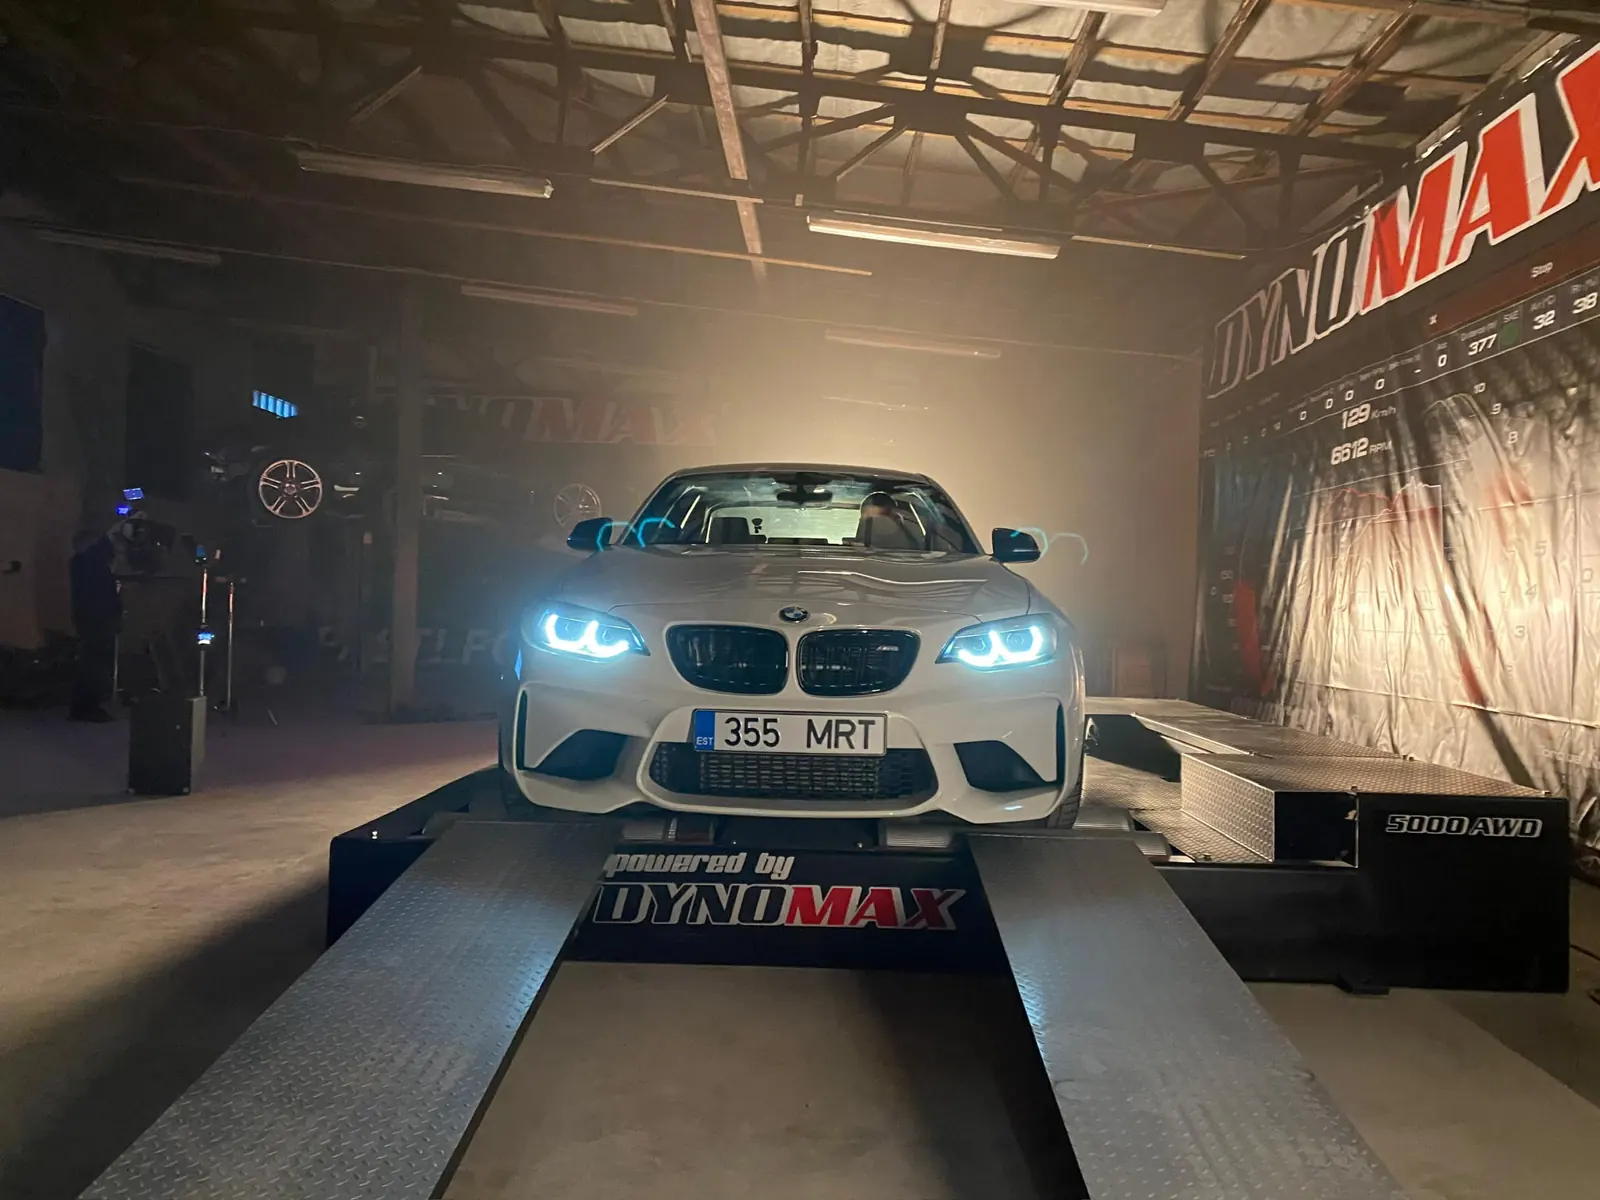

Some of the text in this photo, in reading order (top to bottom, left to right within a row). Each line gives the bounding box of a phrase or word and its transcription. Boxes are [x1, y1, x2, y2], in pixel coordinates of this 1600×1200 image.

[1206, 42, 1600, 399] DYNOMAX
[1530, 262, 1554, 279] Stop
[1572, 292, 1598, 315] 38
[1533, 310, 1556, 330] 32
[1468, 333, 1498, 356] 377
[1438, 354, 1448, 368] 0
[1374, 378, 1385, 391] 0
[1324, 398, 1334, 410] 0
[1344, 390, 1355, 401] 0
[1299, 410, 1308, 421] 0
[1341, 403, 1371, 430] 129
[1489, 402, 1502, 415] 9
[1506, 431, 1519, 444] 8
[1330, 437, 1393, 465] 6612 RPM
[1534, 540, 1548, 557] 5
[1525, 583, 1538, 599] 4
[1514, 625, 1526, 639] 3
[696, 736, 713, 746] EST
[724, 717, 876, 750] 355 MRT
[1386, 814, 1543, 838] 5000 AWD
[603, 852, 795, 880] powered by
[592, 881, 967, 931] DYNOMAX
